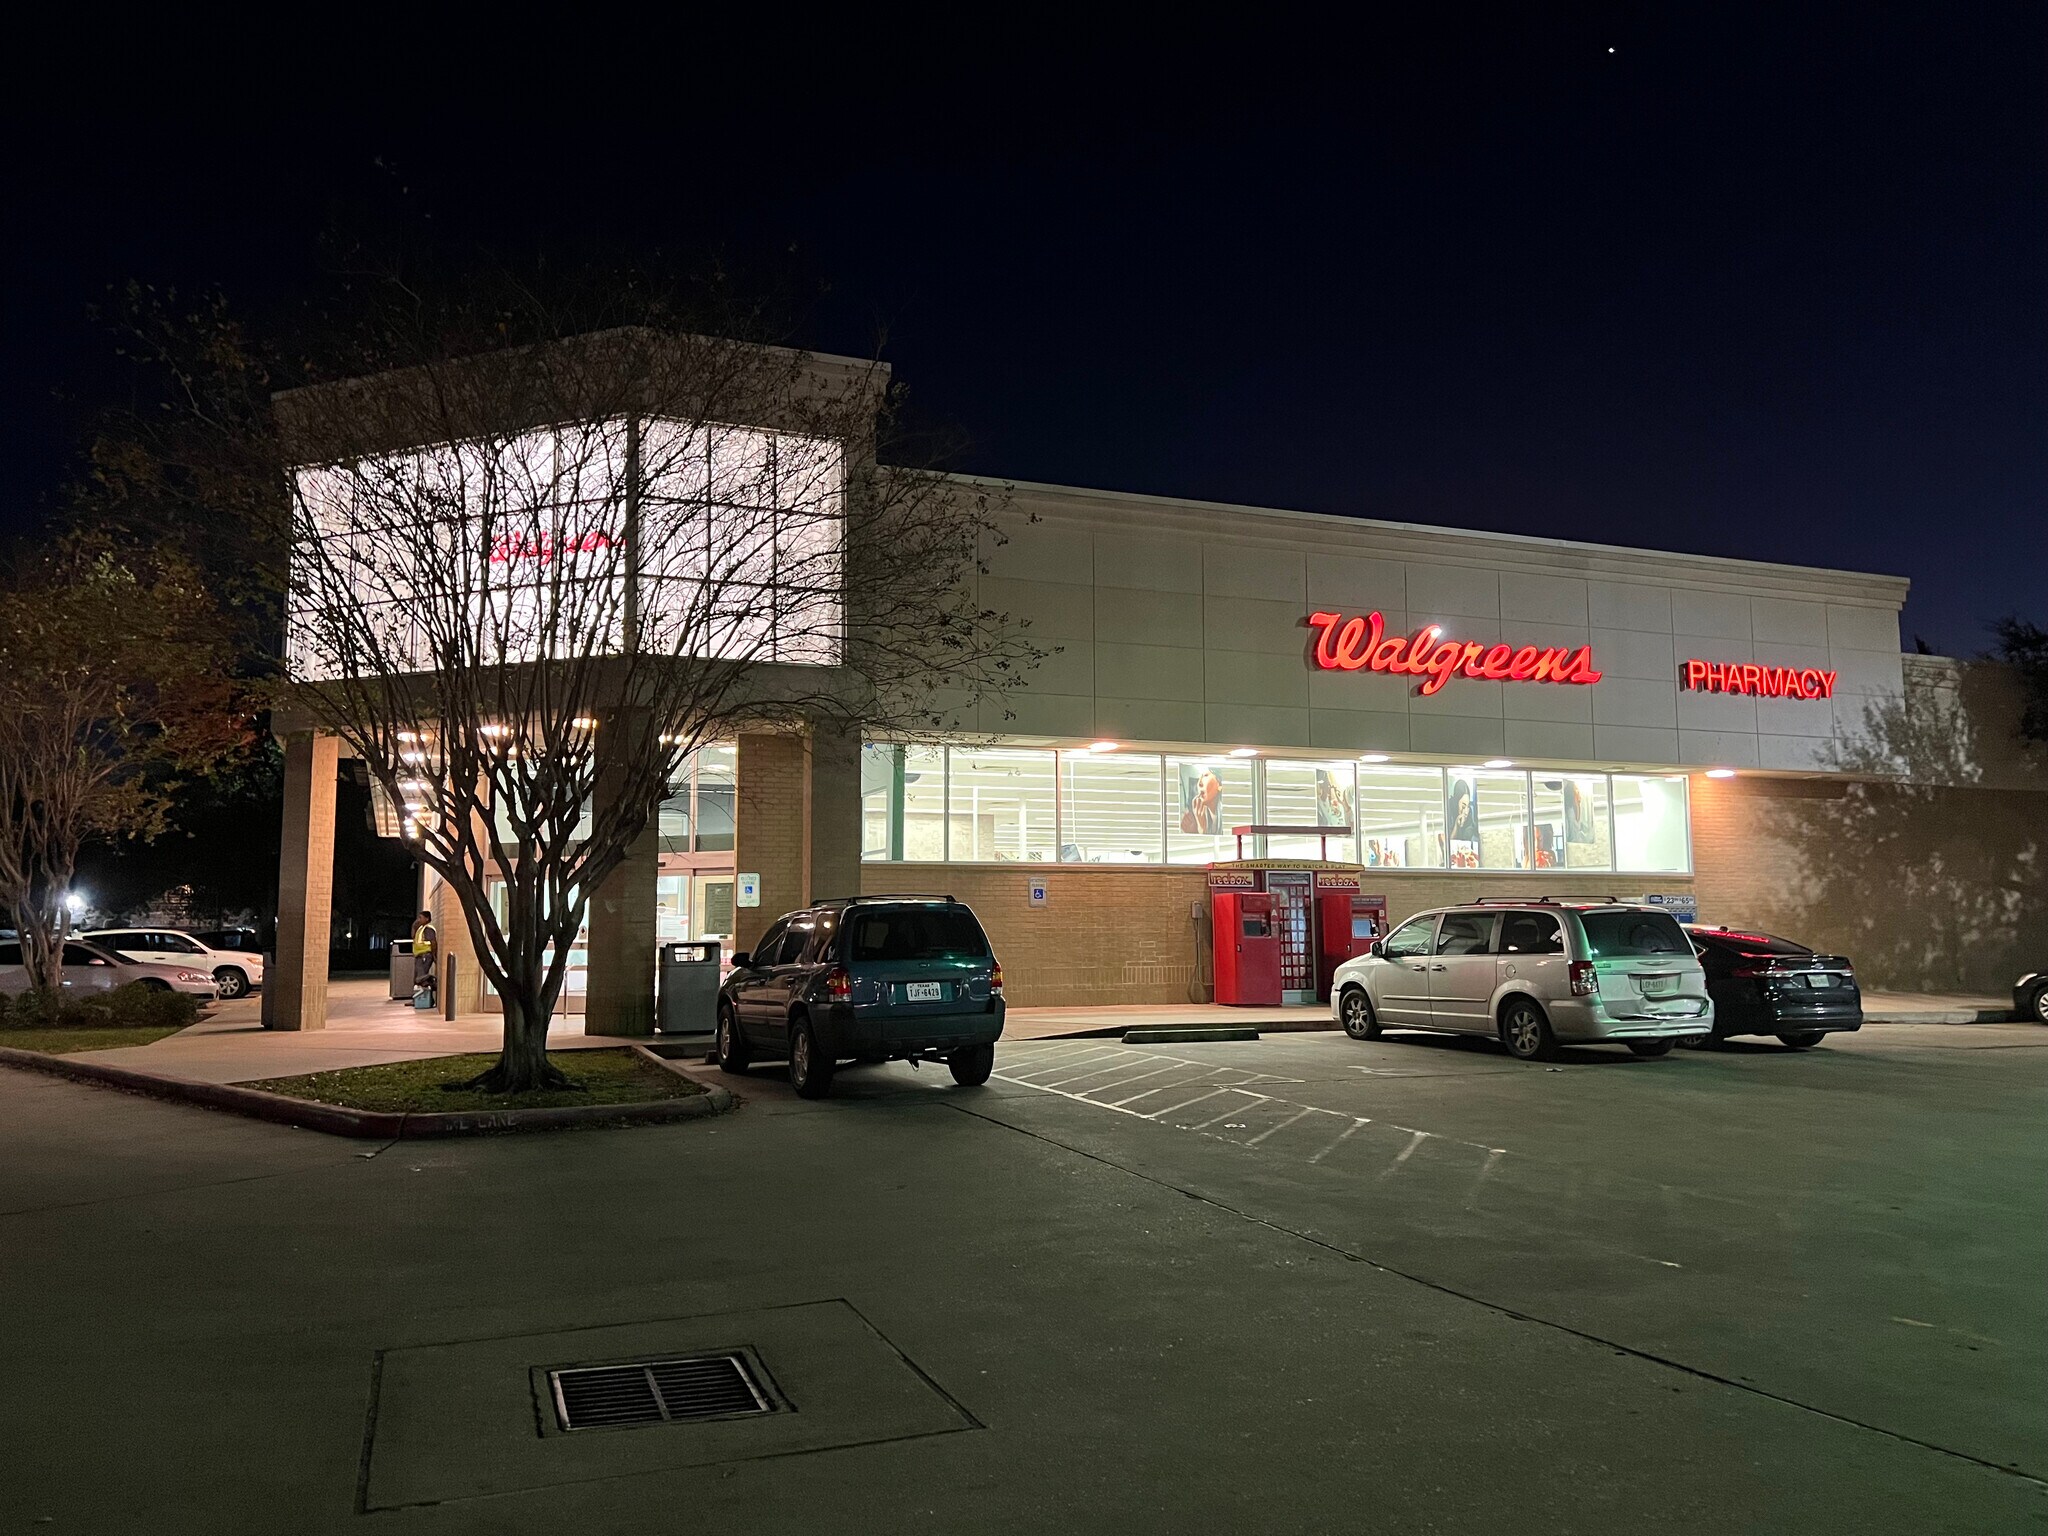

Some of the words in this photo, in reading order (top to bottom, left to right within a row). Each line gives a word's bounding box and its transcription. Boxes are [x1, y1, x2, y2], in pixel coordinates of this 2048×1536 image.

[1310, 611, 1602, 694] Walgreens
[1687, 659, 1836, 699] PHARMACY
[1212, 872, 1251, 886] redbox
[1319, 872, 1357, 886] redbox
